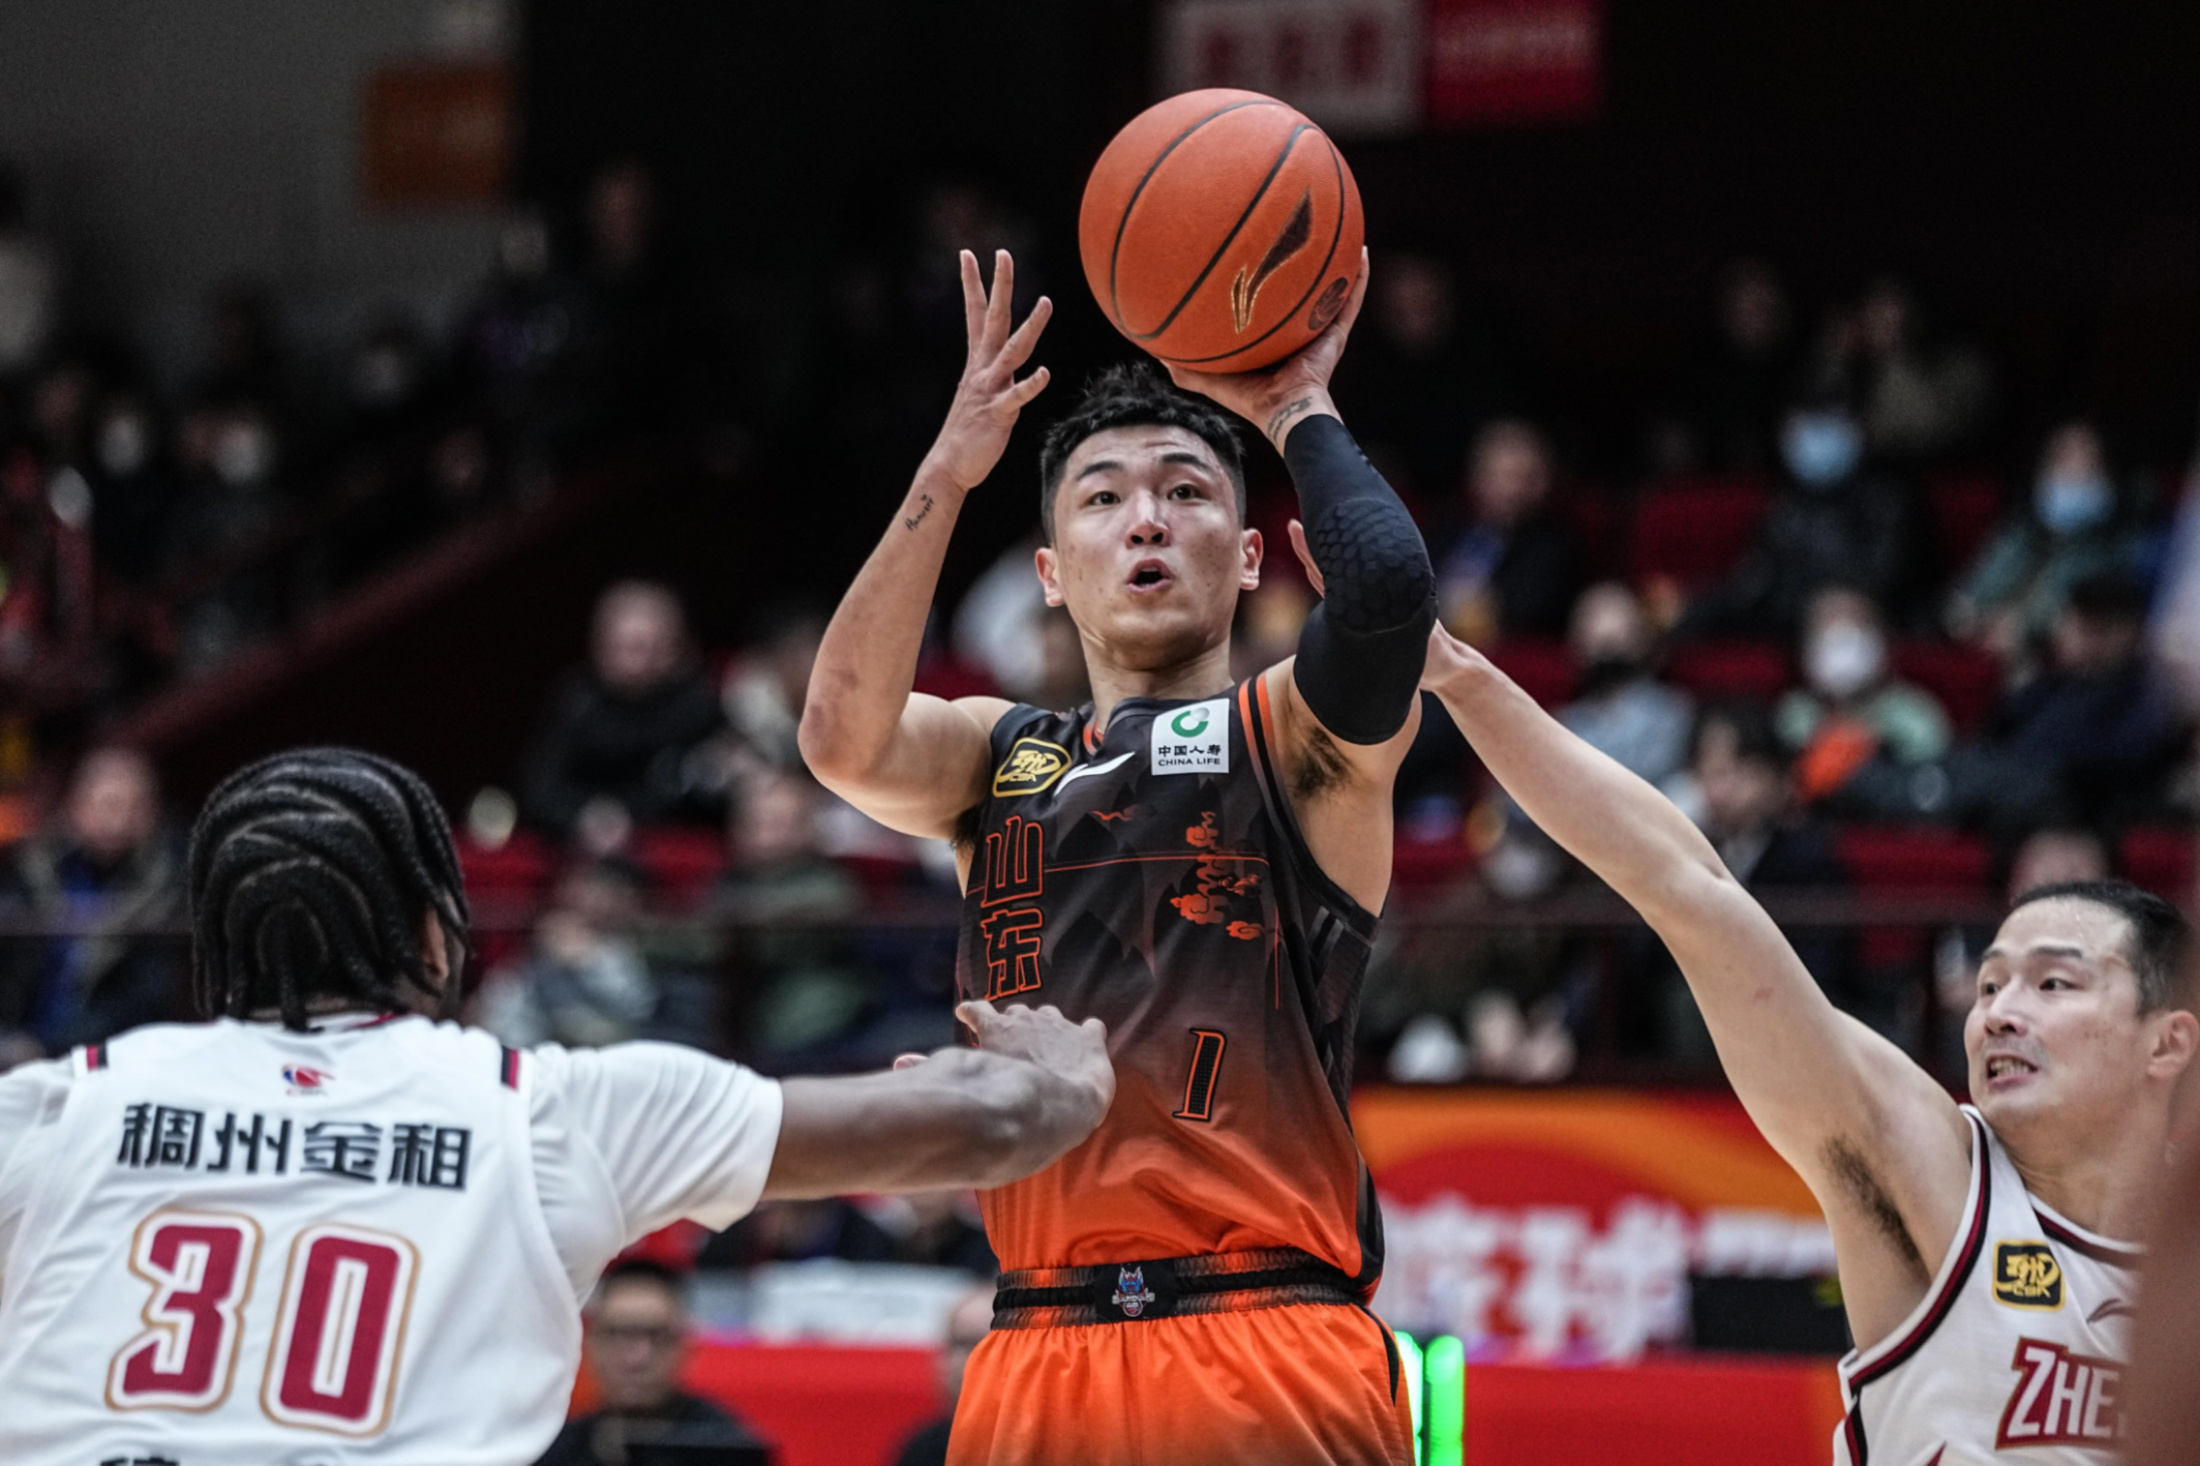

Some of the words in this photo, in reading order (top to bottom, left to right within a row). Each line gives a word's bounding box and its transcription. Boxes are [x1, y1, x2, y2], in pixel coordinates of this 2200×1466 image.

[1158, 744, 1221, 757] 中国人寿
[1158, 758, 1193, 767] CHINA
[1196, 757, 1221, 765] LIFE
[980, 815, 1043, 1001] 山东
[1171, 1027, 1228, 1123] 1
[116, 1103, 472, 1191] 稠州金租
[105, 1207, 420, 1440] 30
[2005, 1345, 2130, 1438] ZHE
